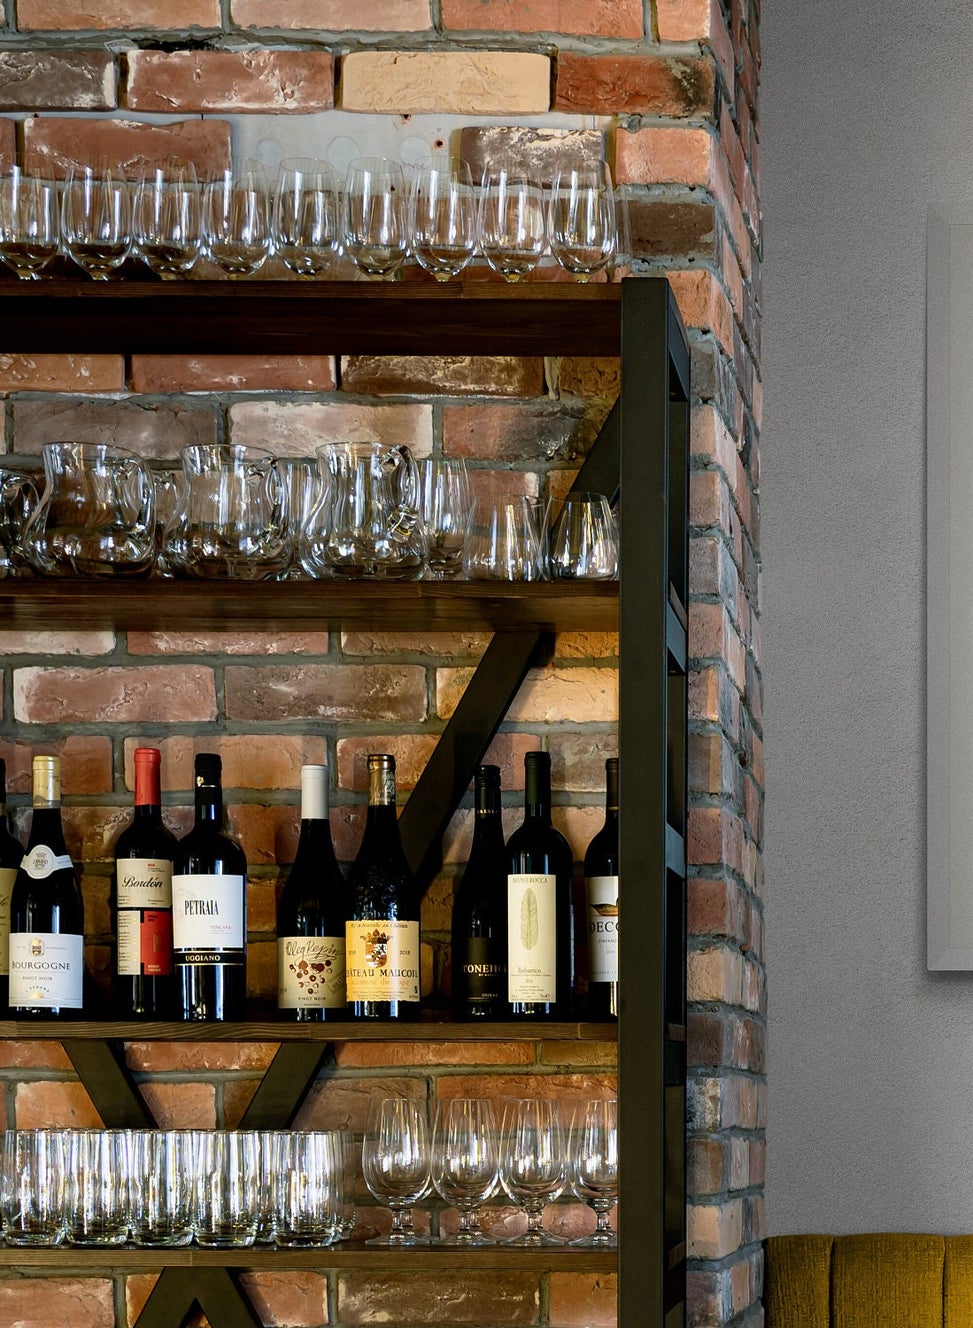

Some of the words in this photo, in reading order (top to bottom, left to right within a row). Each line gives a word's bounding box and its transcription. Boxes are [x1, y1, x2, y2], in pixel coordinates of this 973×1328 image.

[184, 899, 219, 916] PETRAIA
[589, 921, 618, 933] DEC
[11, 961, 71, 971] BOURGOGNE
